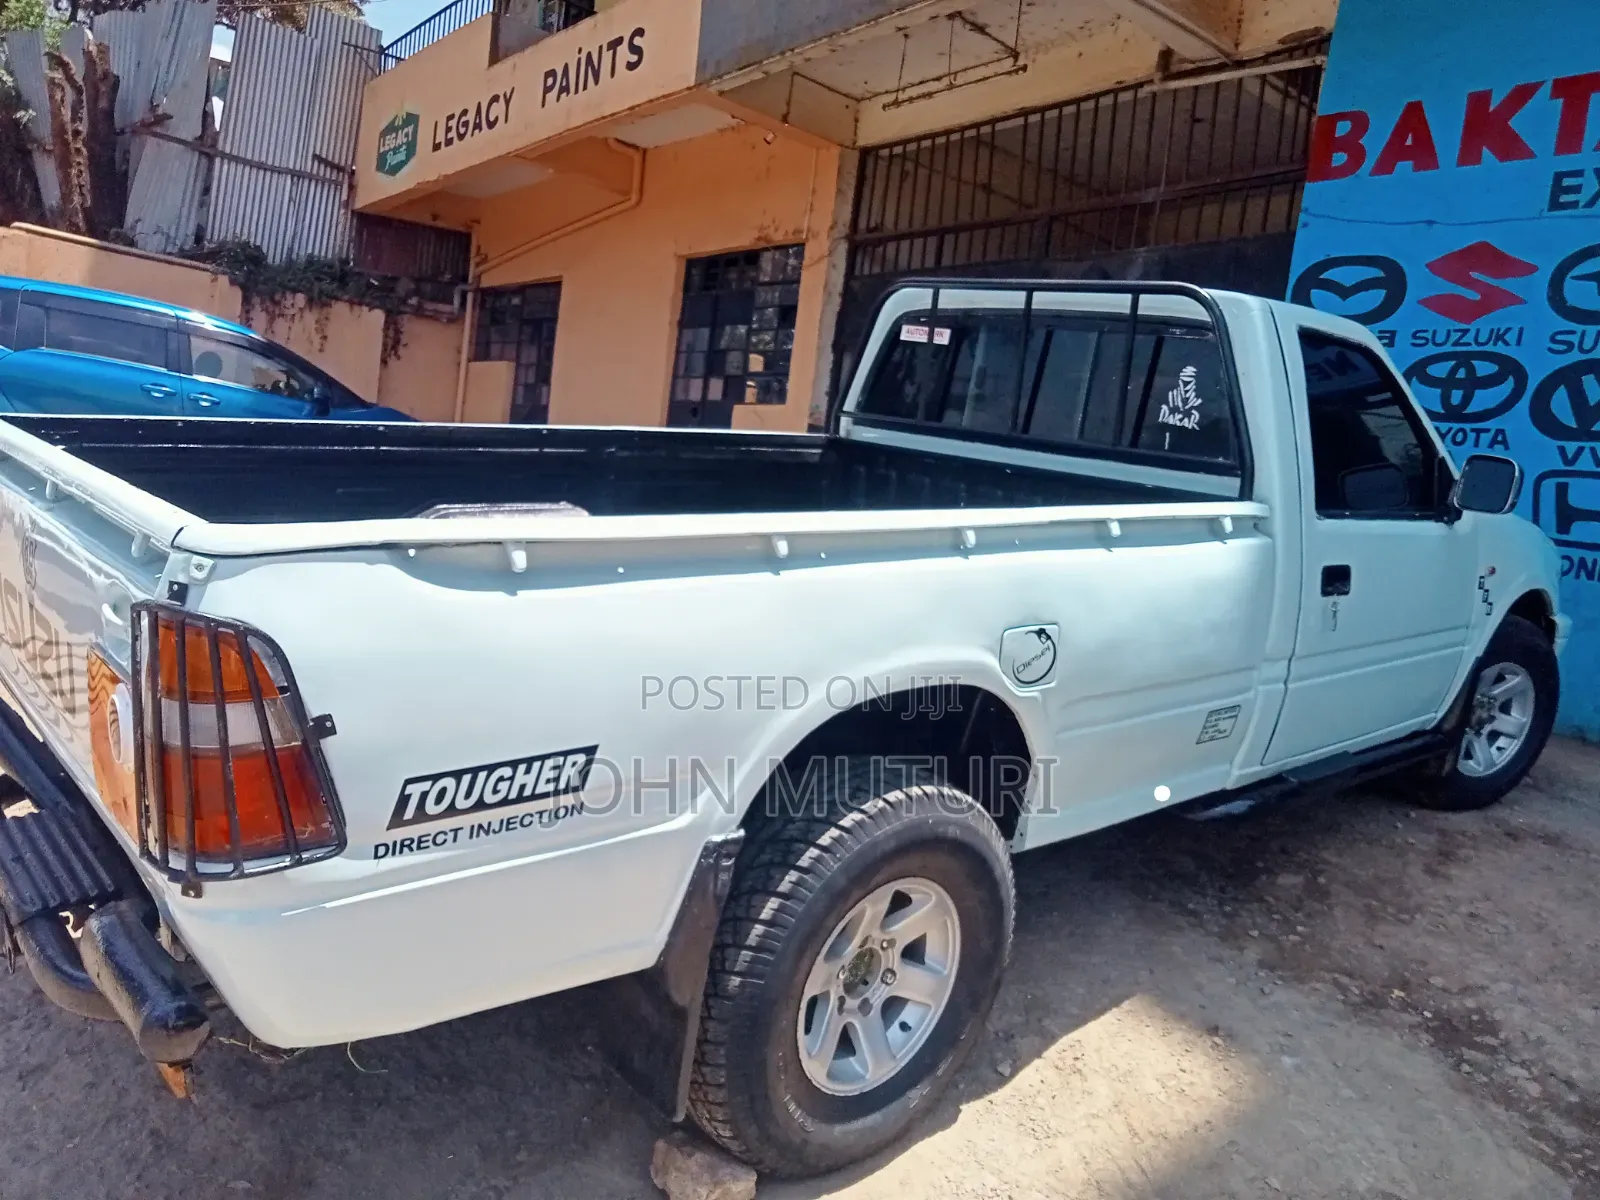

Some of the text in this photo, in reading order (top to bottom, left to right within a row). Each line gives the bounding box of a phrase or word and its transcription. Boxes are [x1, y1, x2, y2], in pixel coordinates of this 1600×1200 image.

[379, 123, 415, 154] LEGACY
[431, 87, 515, 153] LEGACY
[1410, 326, 1525, 348] SUZUKI
[1158, 404, 1200, 430] DAKAR
[402, 753, 587, 821] TOUGHER
[373, 802, 586, 861] DIRECT INJECTION
